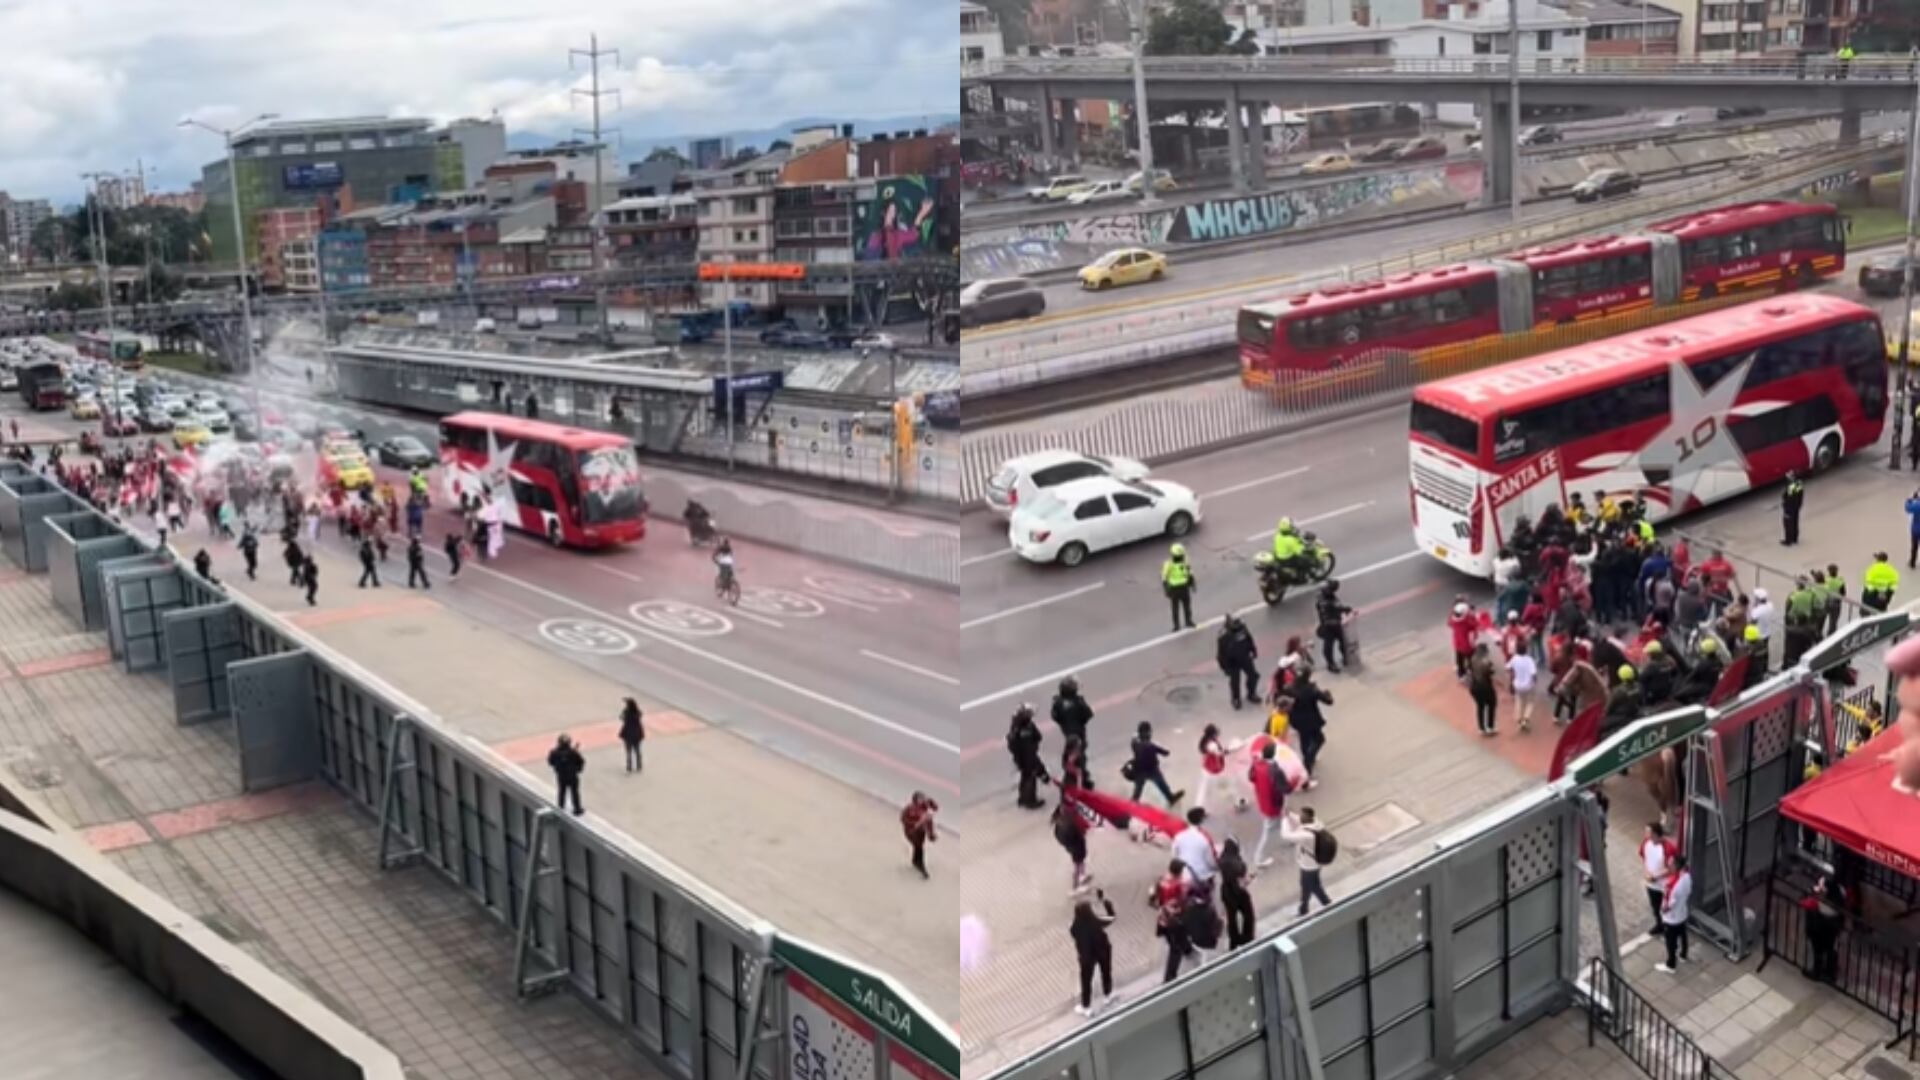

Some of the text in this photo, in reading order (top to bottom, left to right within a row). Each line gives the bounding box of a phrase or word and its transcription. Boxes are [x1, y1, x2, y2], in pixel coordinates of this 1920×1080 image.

[1185, 194, 1292, 240] MHCLUB
[1675, 416, 1717, 464] 10
[1490, 449, 1559, 500] SANTA FE
[1618, 724, 1668, 762] SALIDA
[851, 977, 912, 1037] SALIDA
